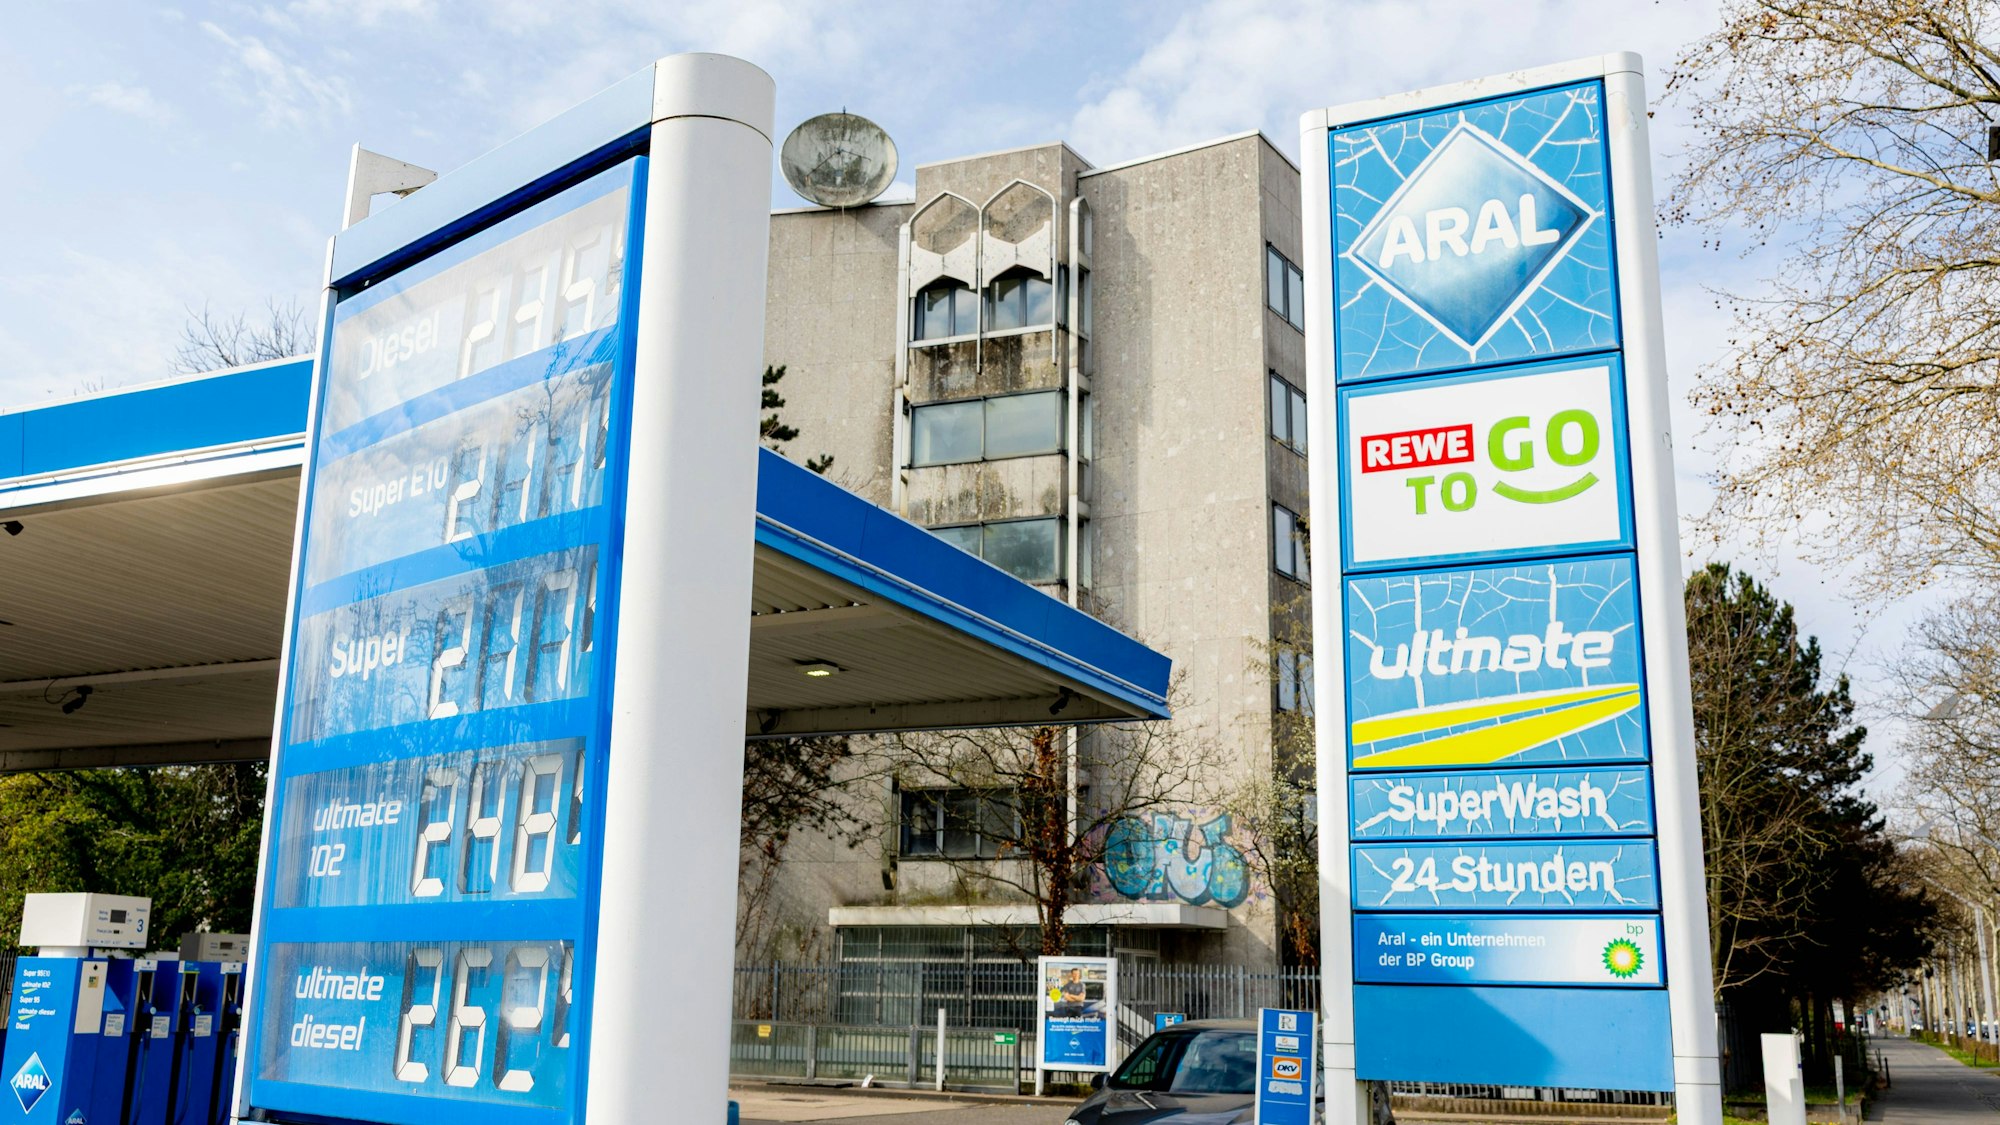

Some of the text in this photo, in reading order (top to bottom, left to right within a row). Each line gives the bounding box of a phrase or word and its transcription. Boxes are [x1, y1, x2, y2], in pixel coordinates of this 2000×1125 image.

[1378, 193, 1561, 269] ARAL
[357, 308, 440, 383] Diesel
[1366, 408, 1600, 472] REWE GO
[349, 474, 407, 518] Super
[409, 455, 449, 496] E10
[1406, 471, 1477, 515] TO
[330, 627, 411, 681] Super
[1370, 621, 1615, 679] ultimate
[313, 793, 403, 832] ultimate
[1388, 780, 1608, 825] SuperWash
[308, 843, 346, 878] 102
[1391, 854, 1614, 892] 24 Stunden
[136, 918, 144, 933] 3
[1378, 932, 1406, 946] Aral
[1420, 931, 1442, 946] ein
[1446, 932, 1546, 947] Unternehmen
[1626, 922, 1644, 935] bp
[241, 946, 247, 955] 5
[1378, 952, 1475, 970] der BP Group
[295, 966, 385, 1002] ultimate
[15, 1022, 30, 1030] Diesel
[290, 1014, 367, 1051] diesel
[15, 1073, 46, 1090] ARAL
[1277, 1064, 1297, 1072] DKV
